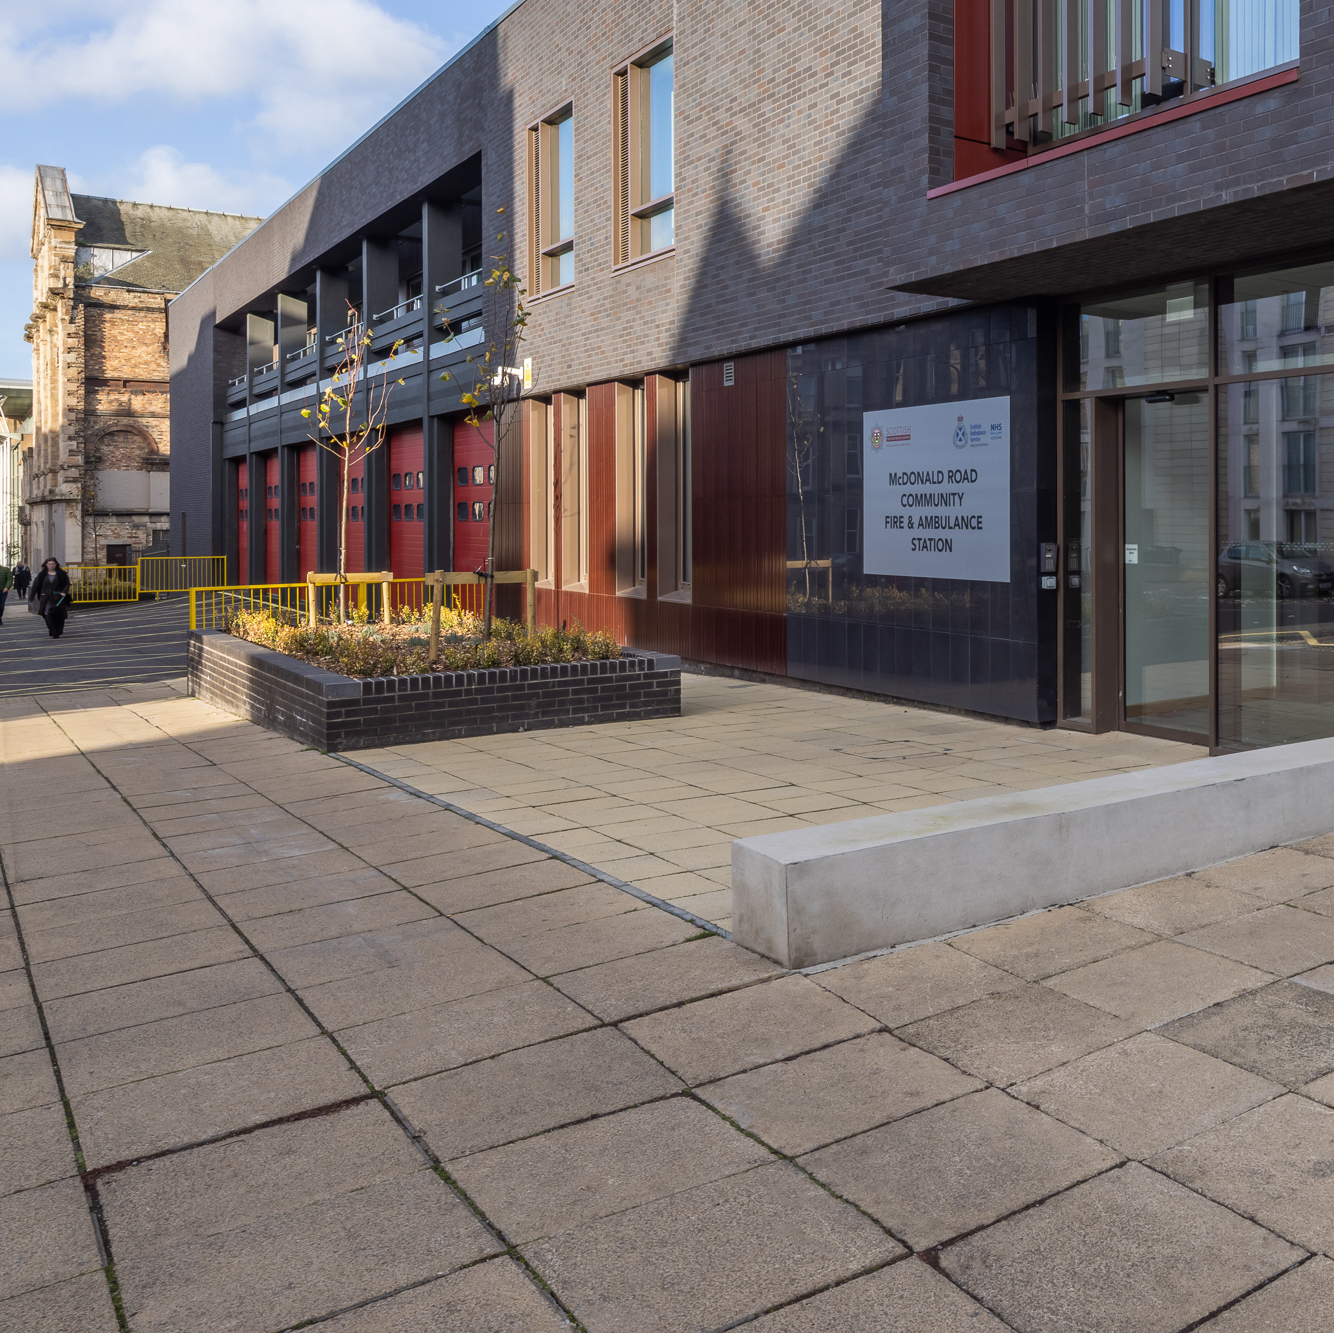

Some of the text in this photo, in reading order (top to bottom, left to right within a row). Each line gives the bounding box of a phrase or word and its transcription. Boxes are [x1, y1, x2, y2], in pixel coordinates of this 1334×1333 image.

[886, 426, 911, 435] SCOTTISH
[990, 423, 1002, 431] NHS
[888, 469, 978, 486] McDONALD ROAD
[900, 492, 964, 508] COMMUNITY
[885, 515, 983, 530] FIRE & AMBULANCE
[911, 537, 953, 553] STATION
